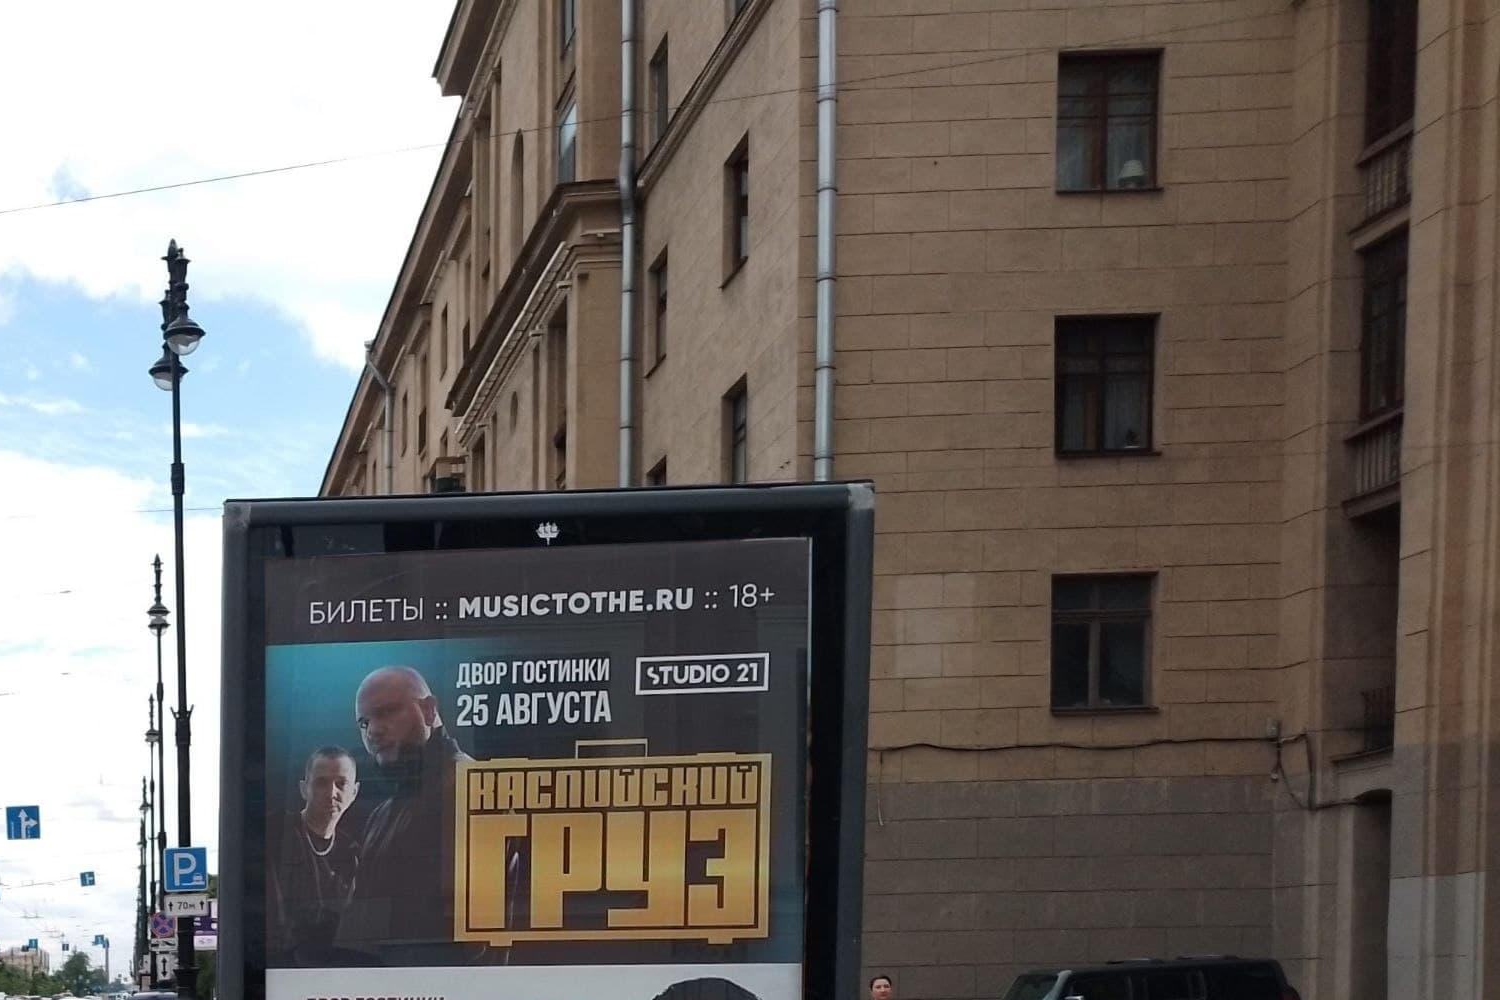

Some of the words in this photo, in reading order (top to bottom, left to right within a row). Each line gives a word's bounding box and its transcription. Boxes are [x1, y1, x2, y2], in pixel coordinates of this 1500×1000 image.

[309, 598, 425, 625] БИЛЕТЫ
[458, 588, 694, 619] MUSICTOTHE.RU
[729, 584, 776, 609] 18+
[456, 662, 508, 689] ДВОР
[512, 658, 610, 685] ГОСТИНКИ
[646, 664, 730, 686] STUDIO
[736, 662, 759, 683] 21
[456, 697, 489, 728] 25
[496, 691, 612, 726] АВГУСТА
[468, 765, 758, 811] КАСПИЙСКИЙ
[468, 808, 757, 929] ГРУЗ
